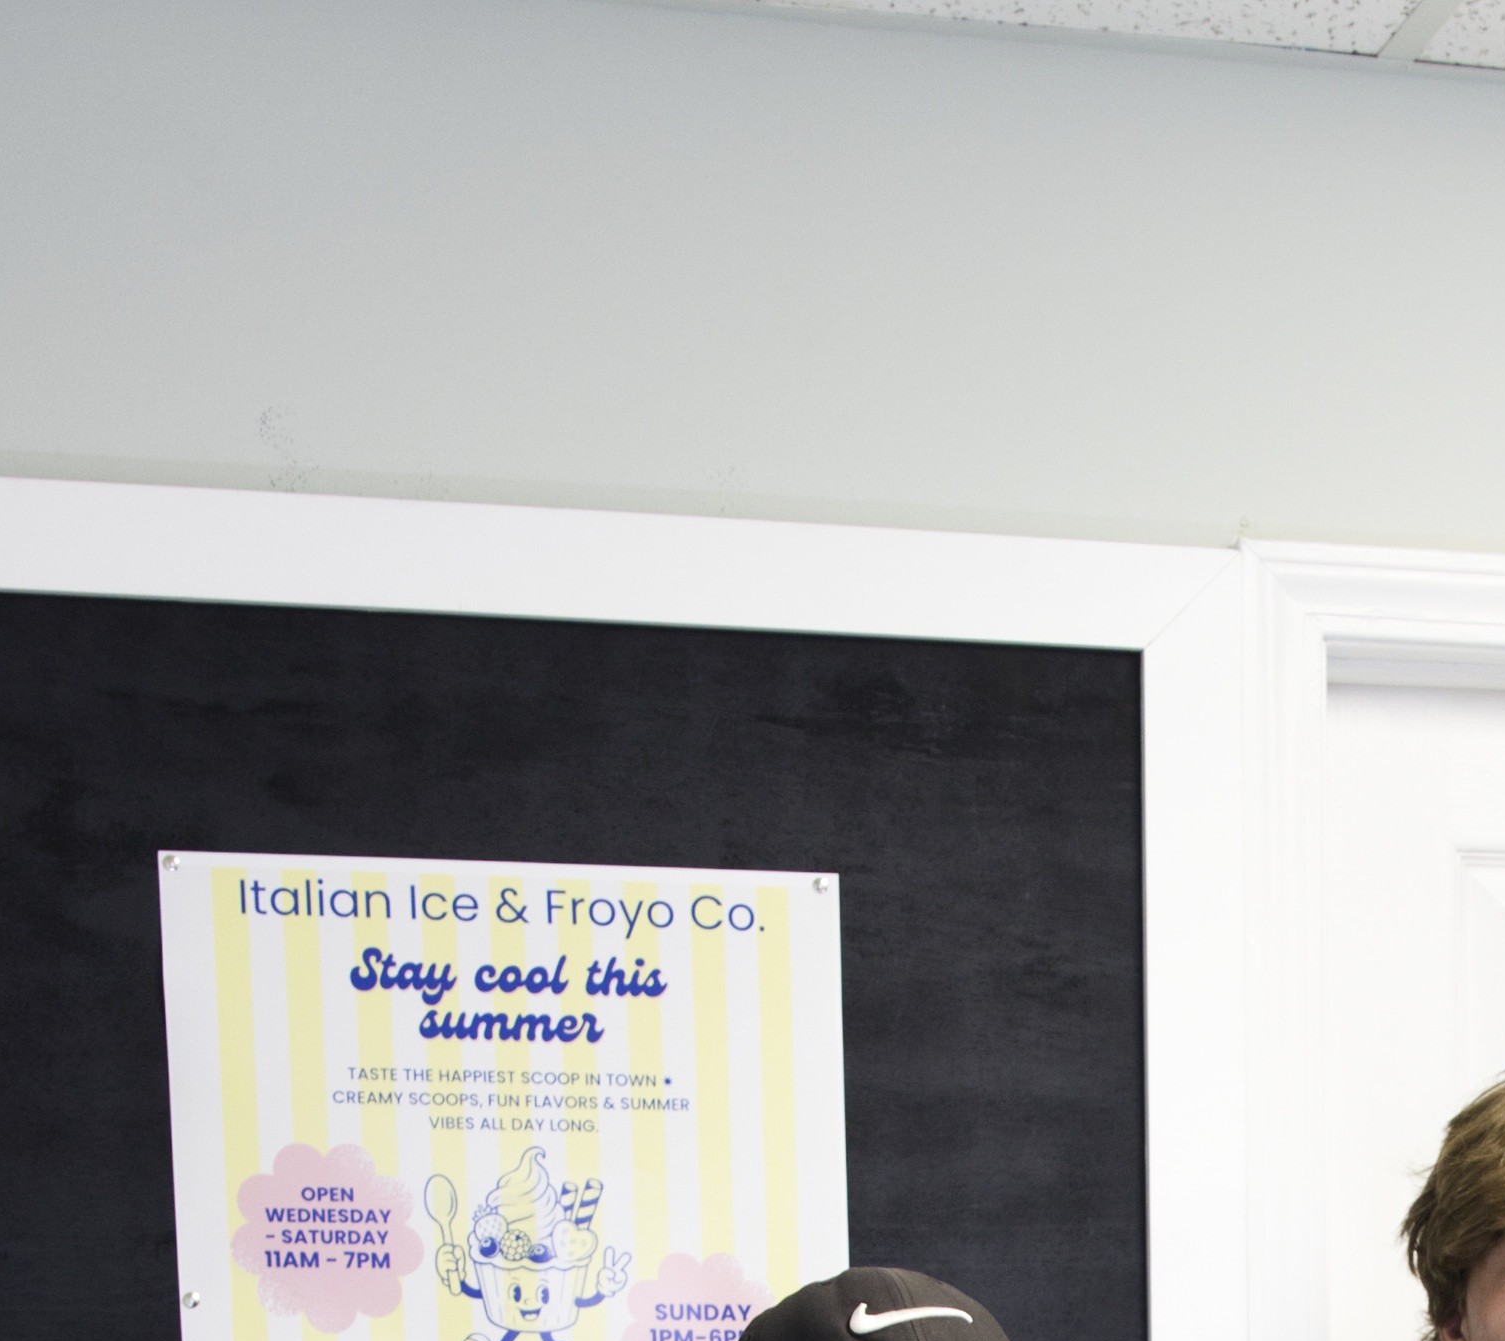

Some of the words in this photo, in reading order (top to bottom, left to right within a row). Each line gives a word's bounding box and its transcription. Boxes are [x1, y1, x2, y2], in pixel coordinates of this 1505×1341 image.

[238, 878, 391, 919] Italian
[410, 885, 478, 921] Ice
[495, 889, 528, 924] &
[546, 890, 674, 938] Froyo
[690, 894, 765, 932] Co.
[350, 947, 456, 1005] Stay
[474, 957, 567, 995] cool
[585, 957, 667, 997] this
[419, 1011, 604, 1043] summer
[348, 1066, 396, 1082] TASTE
[404, 1068, 433, 1084] THE
[438, 1069, 514, 1085] HAPPIEST
[521, 1070, 579, 1086] SCOOP
[585, 1072, 601, 1087] IN
[606, 1072, 657, 1088] TOWN
[332, 1090, 403, 1105] CREAMY
[408, 1091, 481, 1108] SCOOPS,
[488, 1093, 520, 1109] FUN
[525, 1094, 597, 1110] FLAVORS
[603, 1096, 616, 1110] &
[621, 1097, 689, 1111] SUMMER
[429, 1116, 475, 1130] VIBES
[480, 1117, 506, 1131] ALL
[511, 1118, 544, 1132] DAY
[549, 1119, 599, 1133] LONG.
[300, 1186, 354, 1202] OPEN
[265, 1208, 391, 1224] WEDNESDAY
[281, 1229, 389, 1244] SATURDAY
[265, 1252, 321, 1269] 11AM
[343, 1251, 393, 1269] 7PM
[654, 1304, 752, 1321] SUNDAY
